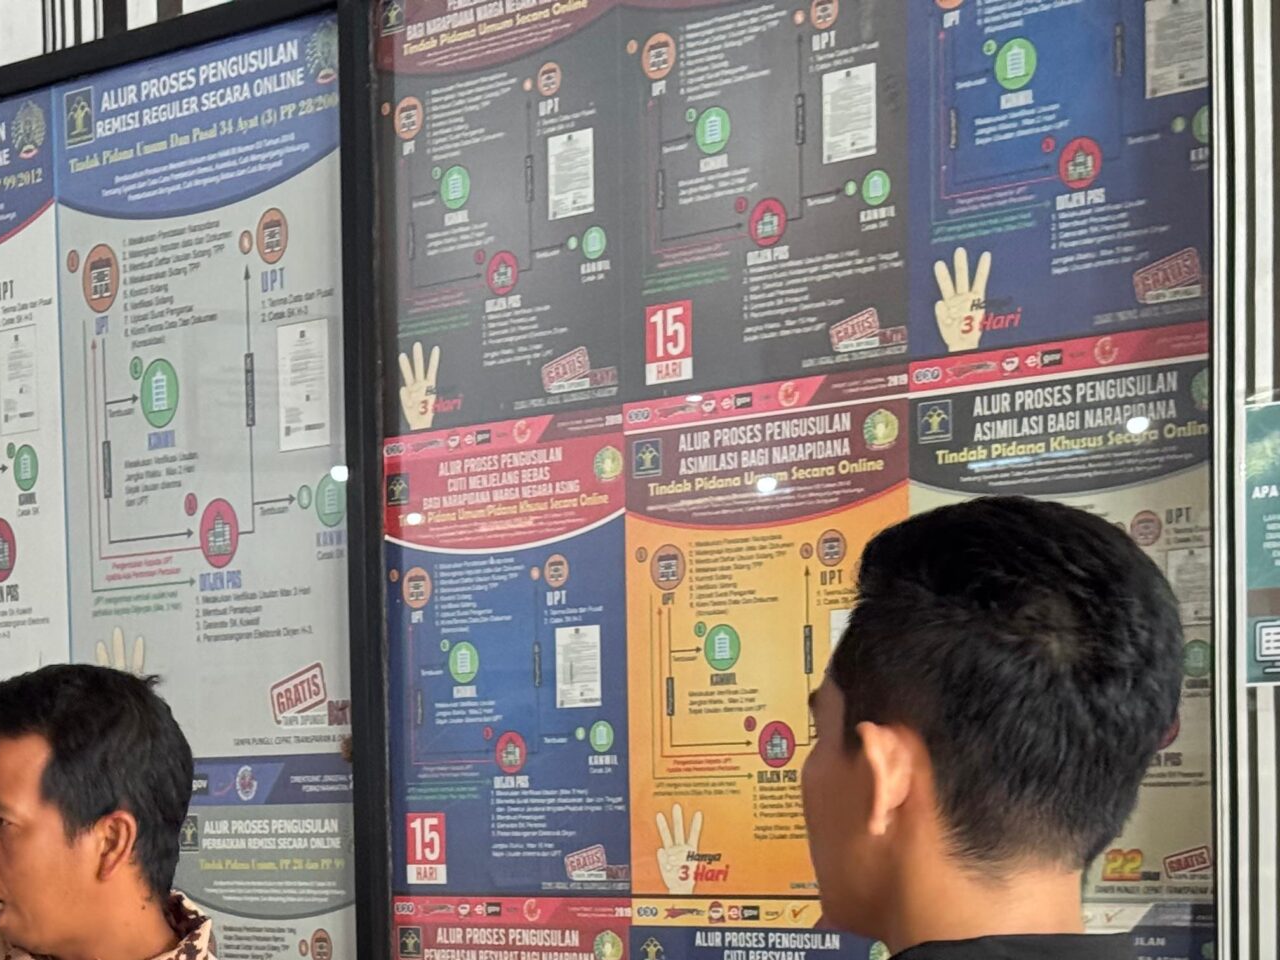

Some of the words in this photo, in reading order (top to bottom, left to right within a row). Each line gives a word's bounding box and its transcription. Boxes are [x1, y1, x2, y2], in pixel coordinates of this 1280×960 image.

[101, 84, 137, 112] ALUR
[141, 68, 196, 101] PROSES
[200, 40, 298, 86] PENGUSULAN
[96, 111, 140, 138] REMISI
[143, 96, 198, 126] REGULER
[201, 82, 250, 111] SECARA
[254, 68, 304, 98] ONLINE
[261, 267, 285, 292] UPT
[650, 307, 685, 357] 15
[961, 316, 974, 334] 3
[980, 307, 1022, 331] Hari
[656, 362, 682, 380] HARI
[419, 400, 429, 415] 3
[974, 392, 1011, 417] ALUR
[1015, 385, 1072, 412] PROSES
[1076, 372, 1178, 404] PENGUSULAN
[679, 431, 710, 452] ALUR
[714, 424, 762, 448] PROSES
[766, 413, 851, 442] PENGUSULAN
[974, 415, 1044, 442] ASIMILASI
[1048, 410, 1080, 433] BAGI
[1084, 399, 1176, 429] NARAPIDANA
[937, 446, 987, 464] Tindak
[992, 440, 1045, 458] Pidana
[1050, 433, 1103, 452] Khusus
[1164, 421, 1208, 441] Onlin
[439, 460, 462, 477] ALUR
[464, 455, 499, 473] PROSES
[501, 447, 562, 469] PENGUSULAN
[680, 452, 738, 475] ASIMILASI
[742, 448, 769, 468] BAGI
[772, 439, 850, 465] NARAPIDANA
[448, 477, 467, 492] CUTI
[469, 471, 519, 489] MENJELANG
[522, 467, 550, 483] BEBAS
[649, 479, 691, 496] Tindak
[695, 474, 741, 491] Pidana
[791, 464, 835, 481] Secara
[838, 459, 884, 476] Online
[1252, 485, 1278, 498] APA
[276, 674, 320, 713] GRATIS
[204, 821, 229, 834] ALUR
[232, 820, 269, 833] PROSES
[272, 819, 340, 833] PENGUSULAN
[411, 818, 440, 860] 15
[202, 839, 246, 850] PERBAIKAN
[248, 839, 275, 849] REMISI
[277, 838, 307, 849] SECARA
[309, 838, 340, 848] ONLINE
[686, 851, 721, 865] Hanya
[1103, 849, 1143, 880] 22
[1168, 853, 1207, 873] GRATIS
[416, 867, 437, 881] HARI
[679, 865, 689, 881] 3
[694, 865, 728, 882] Hari
[437, 928, 463, 944] ALUR
[466, 928, 505, 945] PROSES
[509, 929, 579, 946] PENGUSULAN
[695, 932, 723, 947] ALUR
[725, 933, 765, 948] PROSES
[768, 933, 840, 950] PENGUSULAN
